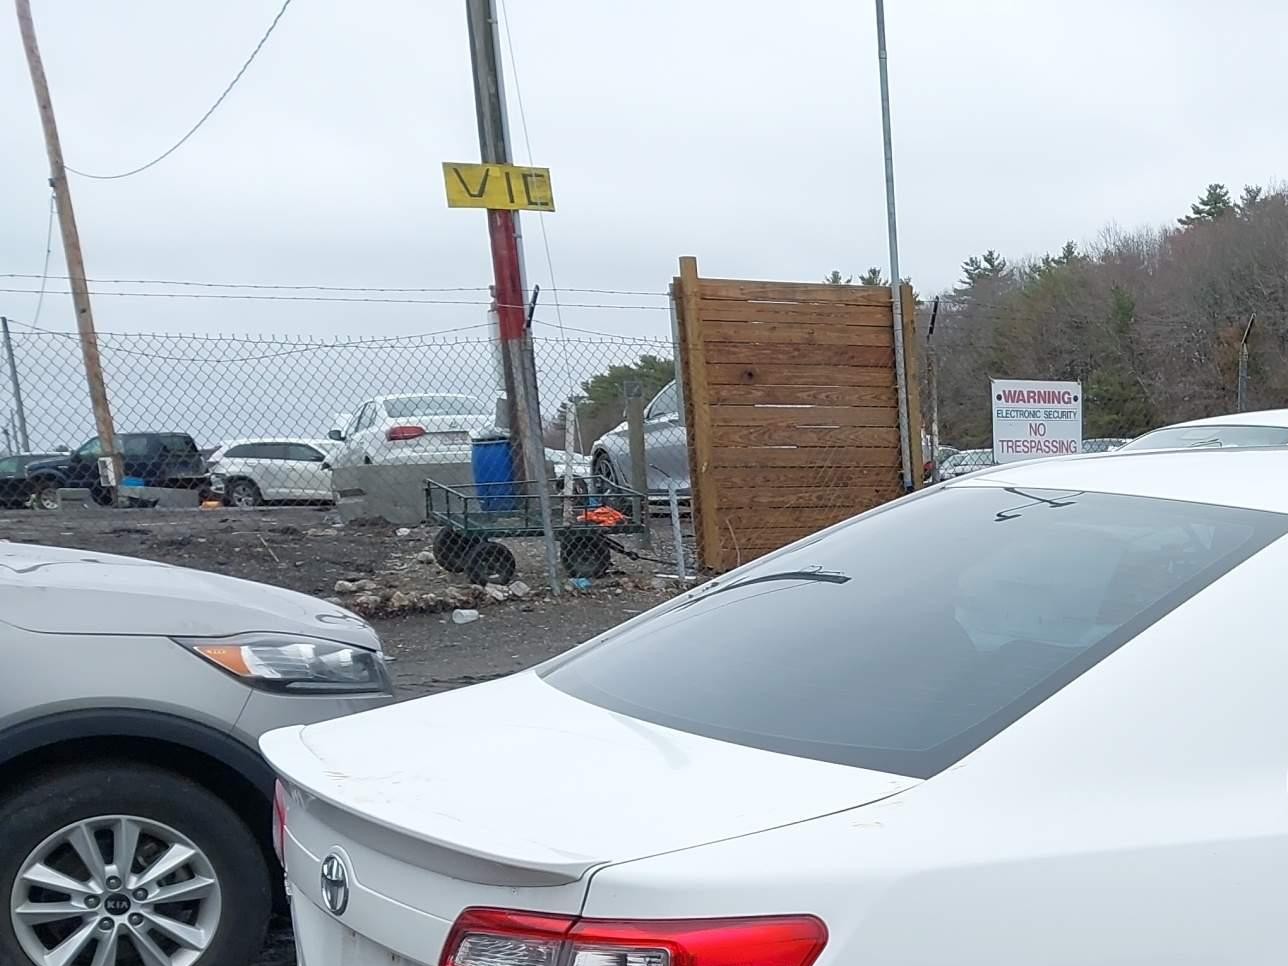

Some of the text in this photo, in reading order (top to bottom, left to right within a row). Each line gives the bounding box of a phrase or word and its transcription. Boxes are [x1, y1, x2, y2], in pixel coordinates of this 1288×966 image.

[1002, 390, 1072, 404] WARNING
[996, 409, 1078, 419] ELECTRONIC SECURITY
[1029, 422, 1047, 437] NO
[999, 439, 1077, 454] TRESPASSING
[107, 900, 128, 909] KIA
